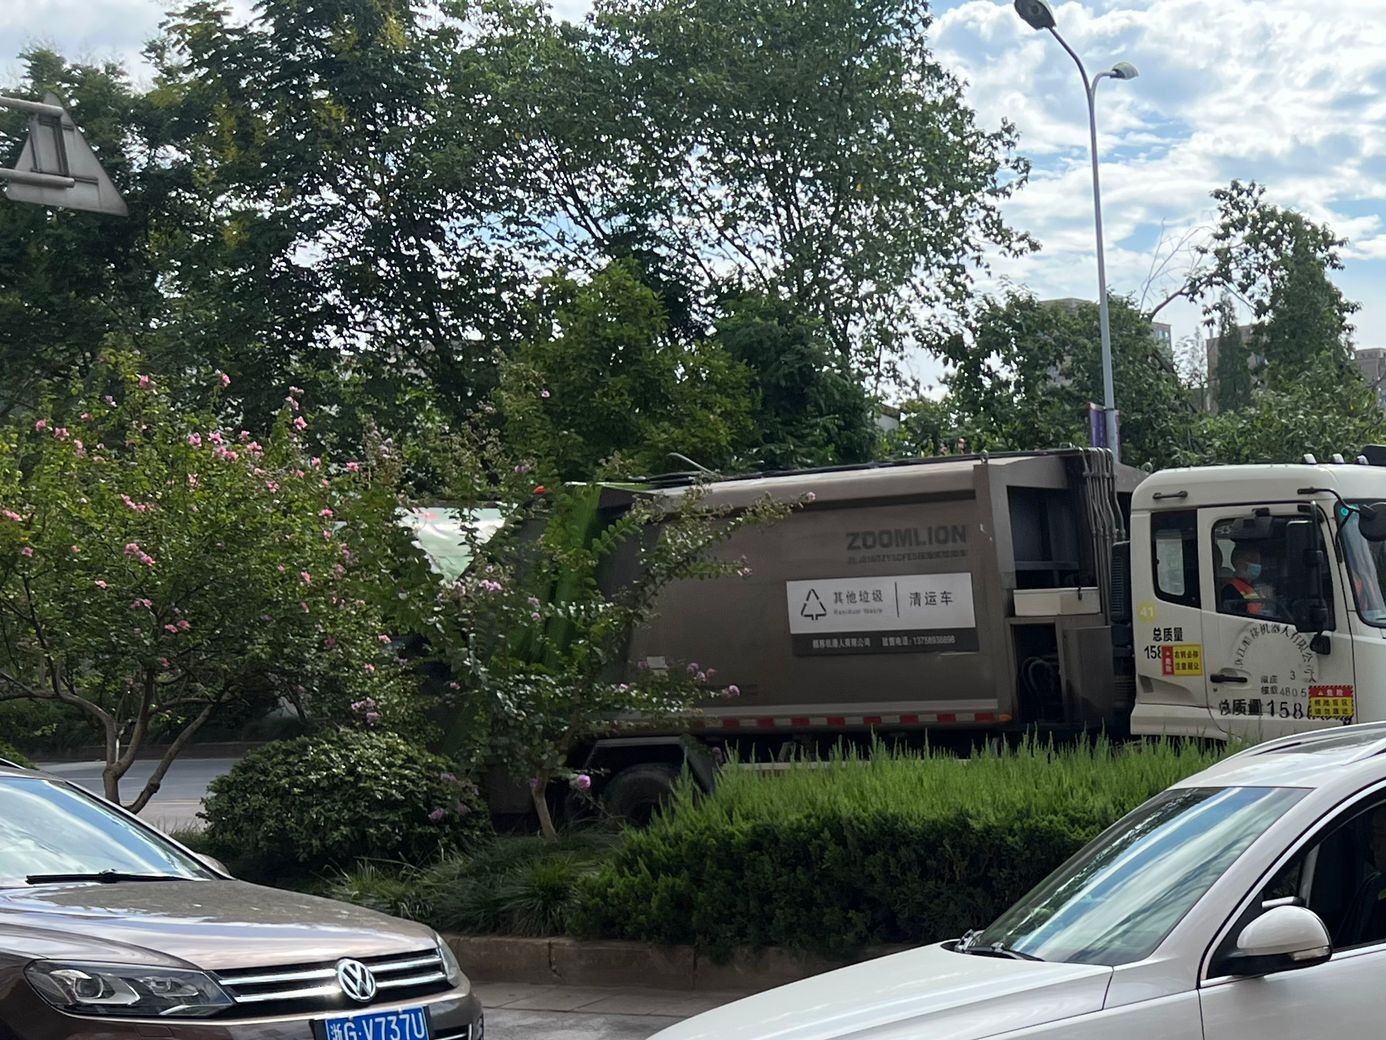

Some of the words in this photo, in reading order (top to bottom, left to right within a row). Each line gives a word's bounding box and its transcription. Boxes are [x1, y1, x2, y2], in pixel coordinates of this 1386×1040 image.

[846, 525, 967, 550] ZOOMLION
[833, 589, 884, 605] 其他垃圾
[909, 590, 953, 607] 清运车
[1152, 627, 1183, 641] 总质量
[1219, 699, 1263, 716] 总质量
